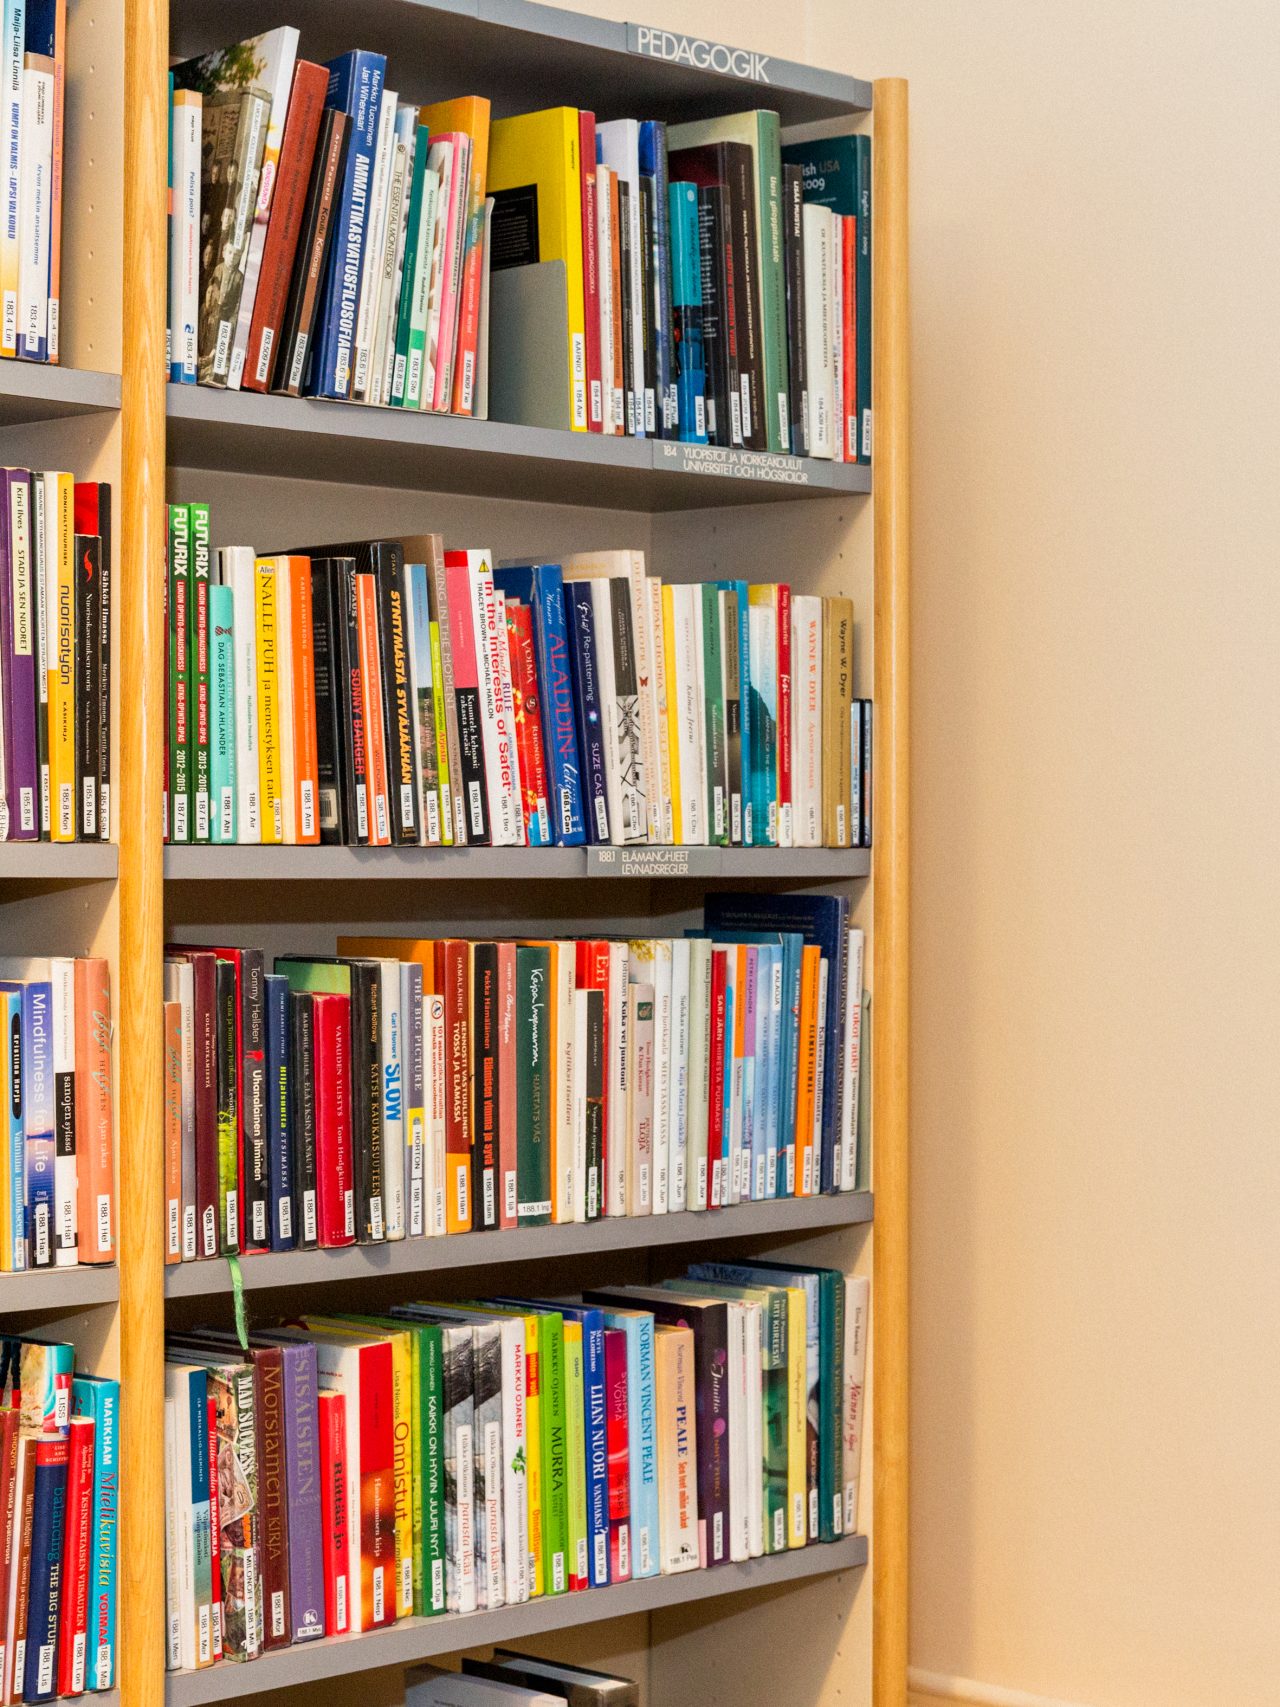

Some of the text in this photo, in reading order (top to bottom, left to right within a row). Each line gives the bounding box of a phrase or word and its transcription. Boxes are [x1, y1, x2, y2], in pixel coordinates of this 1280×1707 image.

[12, 8, 22, 90] Maija-Liisa Linnilä
[637, 26, 770, 83] PEDAGOGIK
[356, 68, 370, 132] Jari Wihersaari
[365, 71, 381, 148] Markku Tuominen
[8, 102, 20, 239] KUMPI ON VALMIS LAPSI VAI KOULU
[311, 207, 328, 279] Koulu Kalliossa
[338, 155, 370, 350] AMMATTIKASVATUSFILOSOFIA
[384, 172, 403, 281] THE ESSENTIAL MONTESSORI
[5, 299, 14, 342] 183.4 Lin
[664, 445, 677, 457] 184
[683, 460, 808, 484] UNIVERSITET OCH HÖGSKOLOR
[728, 452, 739, 463] JA
[16, 487, 25, 529] Kirsi Ilves
[174, 508, 188, 576] FUTURIX
[195, 509, 209, 577] FUTURIX
[17, 549, 28, 650] STADI JA SEN NUORET
[59, 585, 73, 685] nuorisotyön
[177, 582, 185, 671] LUKION OPINTO-OHJAUSKURSSI
[198, 583, 206, 672] LUKION OPINTO-OHJAUSKURSSI
[435, 558, 454, 711] LIVING IN THE MOMENT
[390, 590, 412, 783] SYNTYMÄSTÄ SYVÄJÄÄHÄN
[477, 582, 494, 719] TRACEY BROWN MICHAEL HANLON
[484, 580, 507, 736] In the Interests of
[583, 636, 595, 702] Re-patterning
[838, 619, 848, 697] Wayne W. Dyer
[177, 683, 185, 742] JATKO-OPINTO-OPAS
[199, 684, 207, 743] JATKO-OPINTO-OPAS
[261, 575, 276, 809] NALLE PUH ja menestyksen taito
[351, 668, 365, 774] SONNY BARGER
[460, 695, 472, 756] rakasta itseäsi!
[467, 694, 480, 768] Kuuntele kehoasi:
[532, 725, 543, 798] RHONDA BYRNE
[592, 743, 600, 770] SUZE
[177, 801, 185, 833] 187 Fut
[304, 788, 312, 810] 188.1
[622, 863, 689, 874] LEVNADSREGLER
[249, 967, 261, 1042] Tommy Hellsten
[414, 976, 422, 1091] THE BIG PICTURE
[32, 993, 48, 1172] Mindfulness for Life
[335, 1025, 343, 1075] VAPAUDEN
[62, 1075, 73, 1152] sanojen sylissä
[253, 1069, 263, 1180] Uhanalainen ihminen
[385, 1063, 401, 1121] SLOW
[371, 1064, 380, 1196] KATSE KAUKAISUUTEEN
[414, 1132, 422, 1169] HORTON
[336, 1146, 345, 1201] Hodgkinson
[99, 1202, 108, 1243] 188.1 Hel
[238, 1376, 255, 1475] MAD SUCCESS
[294, 1358, 314, 1497] SISÄISEEN
[515, 1394, 523, 1437] OJANEN
[551, 1377, 560, 1416] OJANEN
[639, 1323, 654, 1485] NORMAN VINCENT PEALE
[676, 1406, 688, 1457] PEALE
[263, 1366, 282, 1559] Morsiamen KIRJA
[394, 1422, 409, 1521] Onnistut
[428, 1395, 439, 1556] KAIKKI ON HYVIN JUURI NYT
[551, 1426, 563, 1491] MURRA
[591, 1385, 608, 1534] LIIAN NUORI VANHAKSI?
[99, 1397, 116, 1645] MARKHAM Mielikuvista VOIMAA
[210, 1496, 218, 1556] TERAPIAKIRJA
[333, 1462, 344, 1550] Riittää jo
[460, 1502, 472, 1575] parasta ikää
[488, 1499, 500, 1571] parasta ikää
[49, 1487, 65, 1612] balancing THE BIG
[76, 1488, 91, 1626] YKSINKERTAISEN VIISAUDEN
